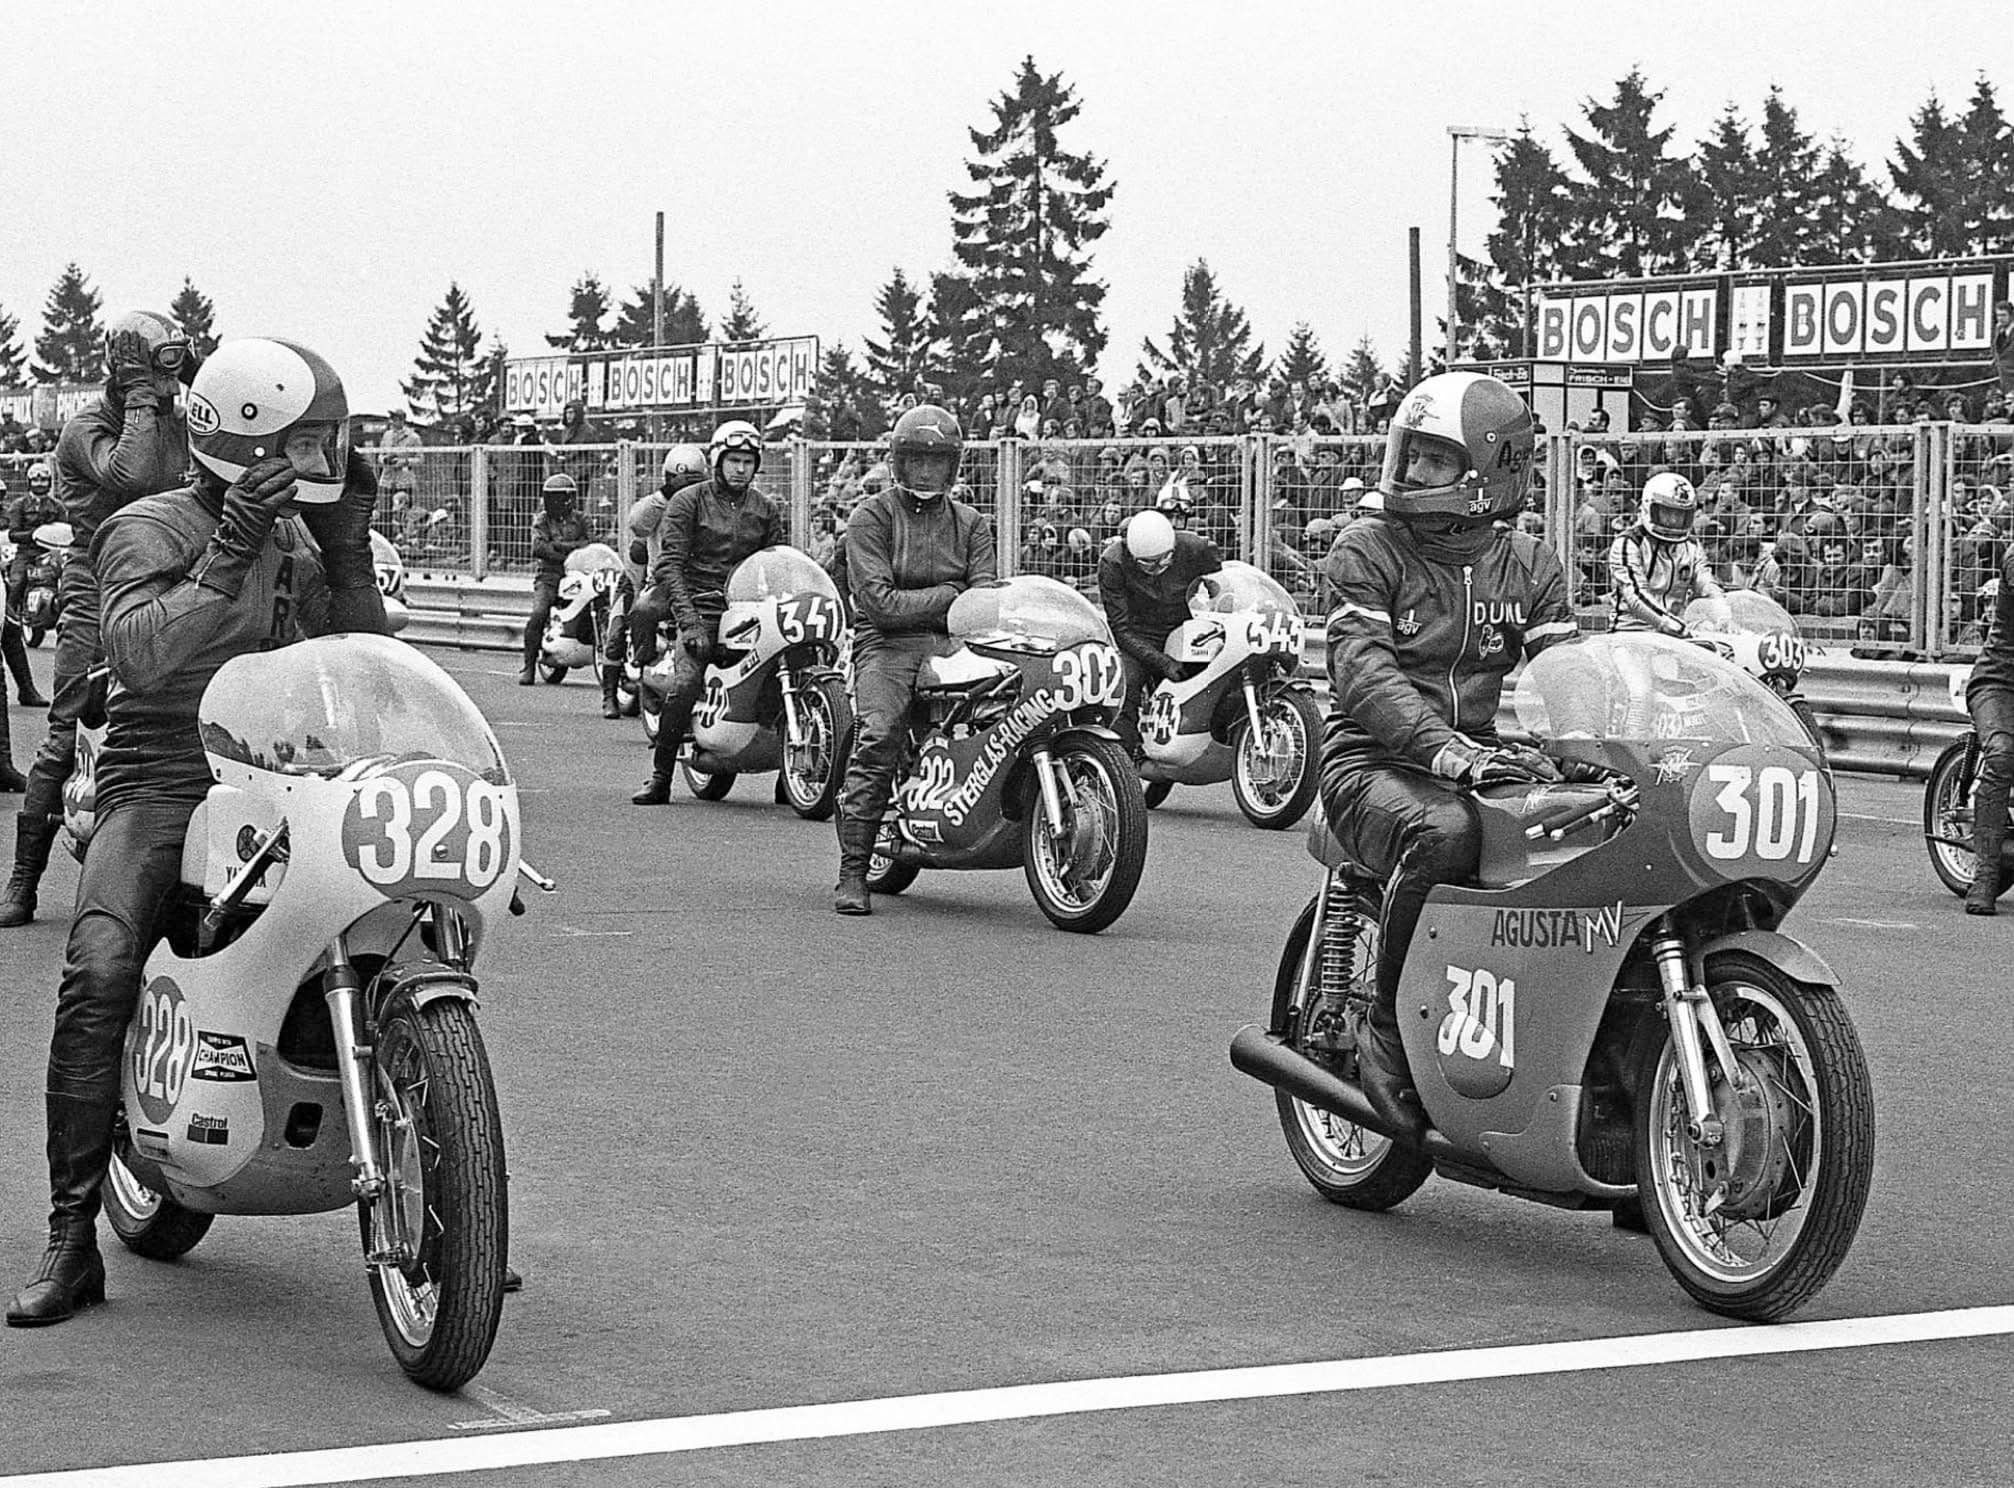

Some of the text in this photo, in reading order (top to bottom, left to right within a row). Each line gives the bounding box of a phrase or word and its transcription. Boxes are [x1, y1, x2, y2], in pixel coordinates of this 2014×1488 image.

[1543, 298, 1711, 356] BOSCH
[1791, 284, 1986, 346] BOSCH
[509, 369, 579, 405] BOSCH
[611, 363, 688, 401] BOSCH
[725, 354, 807, 394] BOSCH
[1469, 498, 1493, 513] agv
[778, 596, 837, 643] 341
[1397, 621, 1421, 636] agv
[1764, 634, 1804, 669] 303
[1052, 643, 1122, 711] 302
[908, 755, 954, 811] 302
[358, 770, 503, 887] 328
[1706, 764, 1819, 863] 301
[1491, 900, 1624, 954] AGUSTA MV
[1438, 964, 1514, 1068] 301
[136, 990, 191, 1105] 328
[199, 1049, 246, 1067] CHAMPION
[191, 1112, 228, 1129] Castrol
